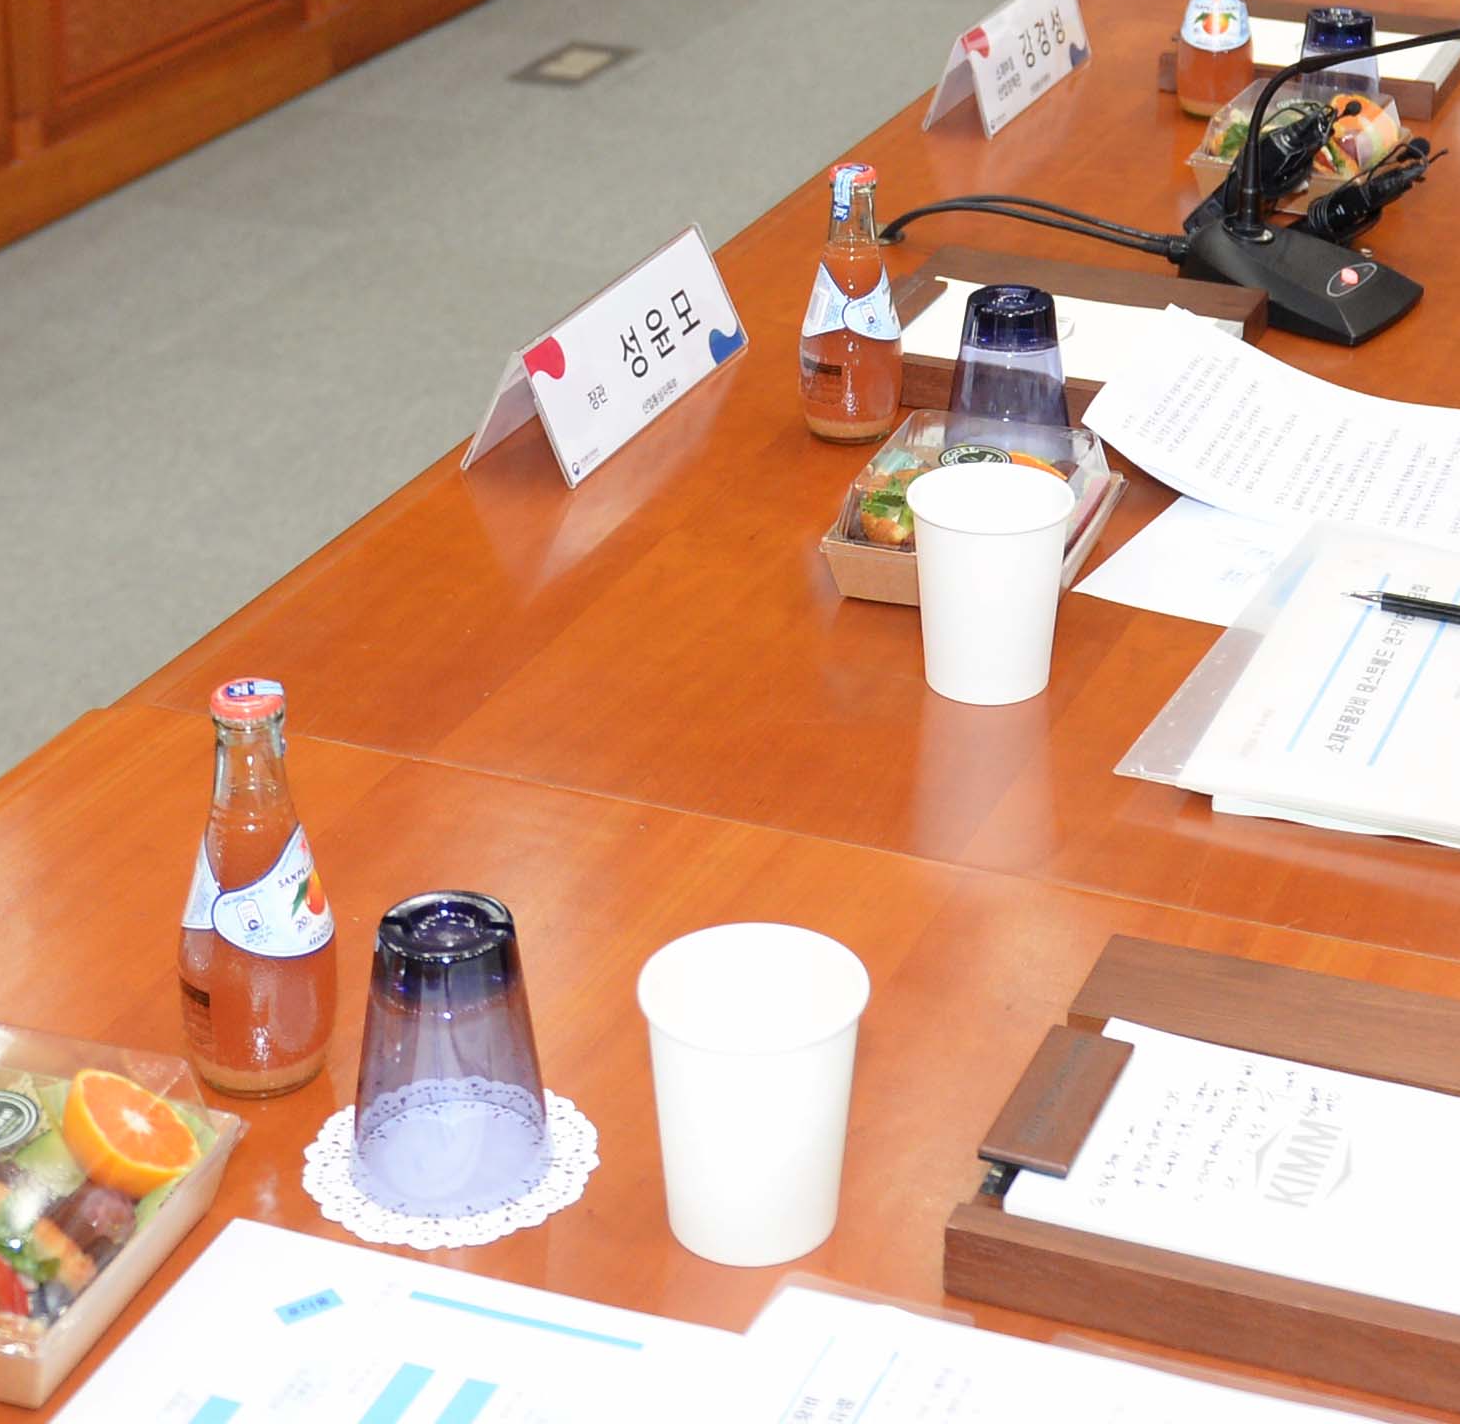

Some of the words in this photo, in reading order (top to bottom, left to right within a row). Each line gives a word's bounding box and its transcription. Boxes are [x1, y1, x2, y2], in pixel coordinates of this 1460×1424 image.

[620, 289, 700, 378] 성윤모
[587, 384, 609, 410] 장관
[1263, 1119, 1343, 1207] KIMM
